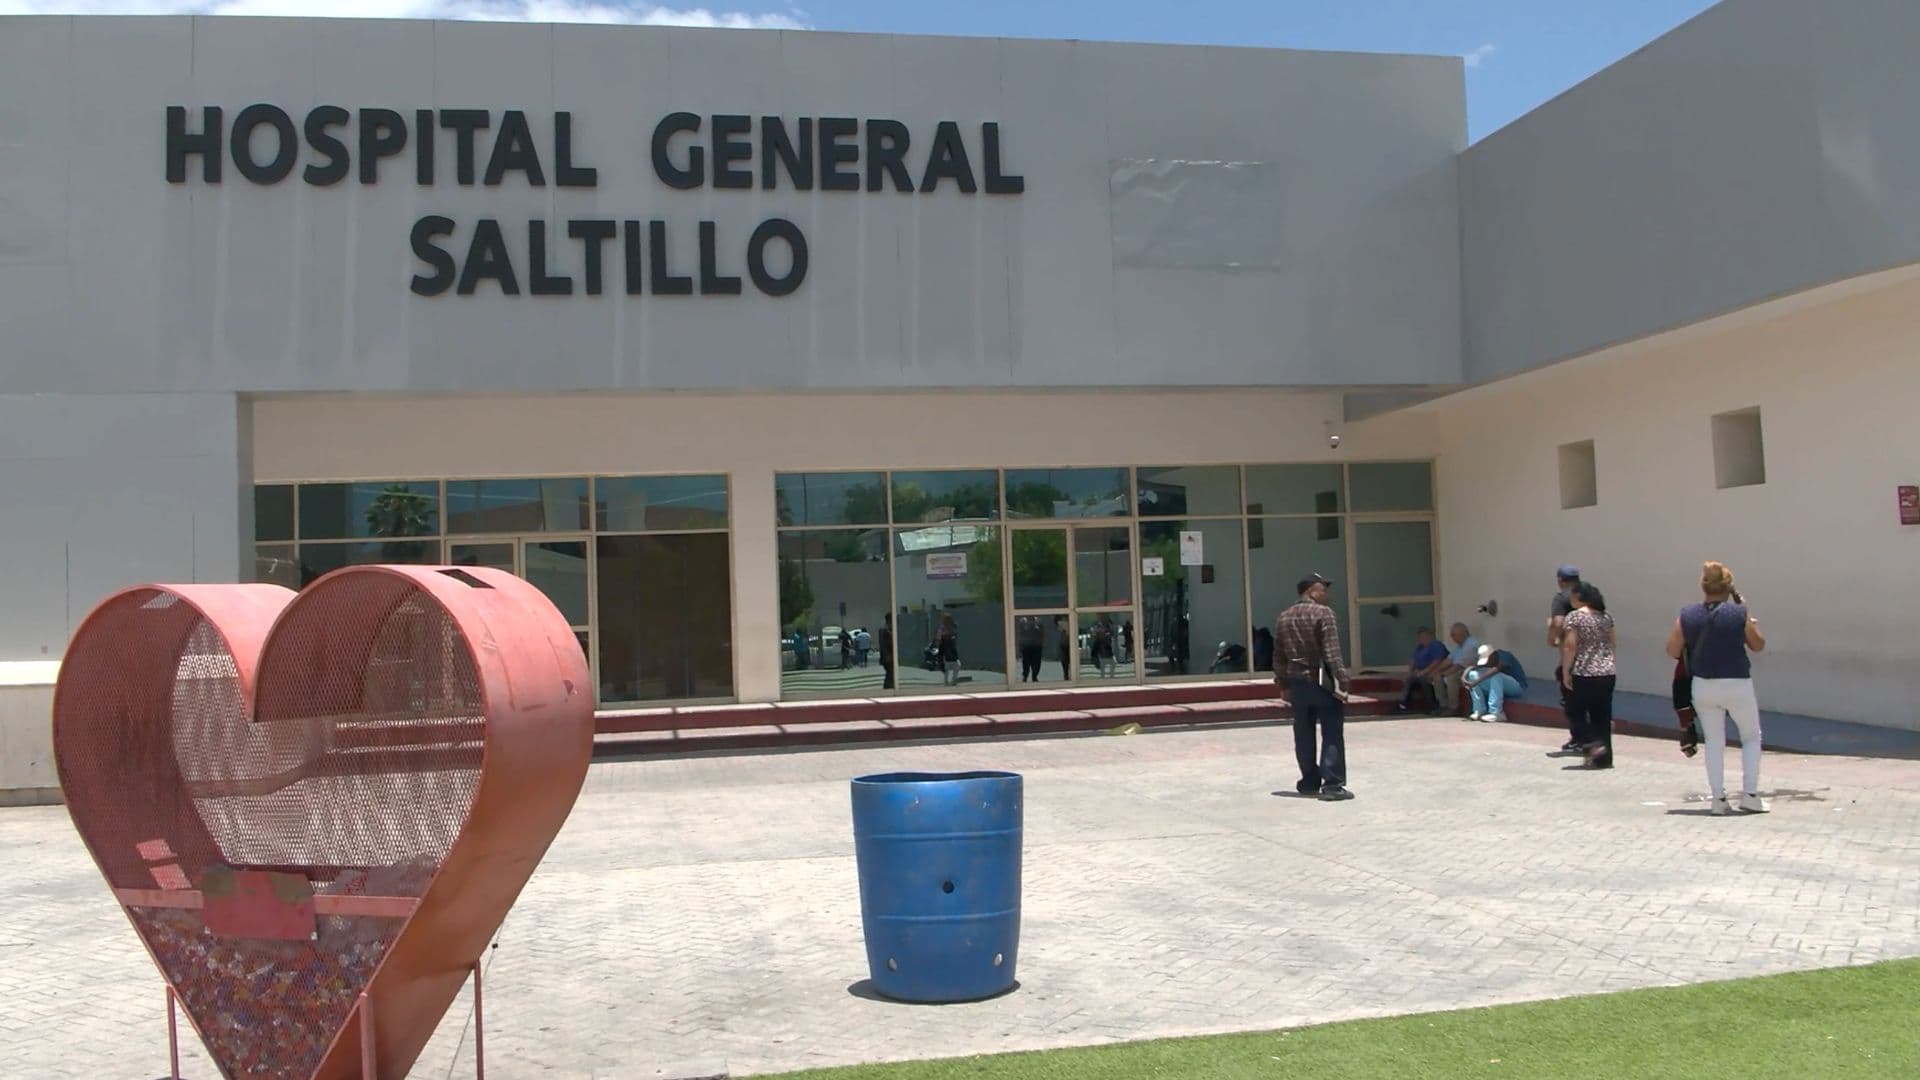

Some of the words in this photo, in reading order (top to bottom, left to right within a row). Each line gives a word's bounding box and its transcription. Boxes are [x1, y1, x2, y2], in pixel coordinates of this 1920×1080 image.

[165, 103, 598, 188] HOSPITAL
[650, 111, 1025, 195] GENERAL
[409, 215, 809, 298] SALTILLO
